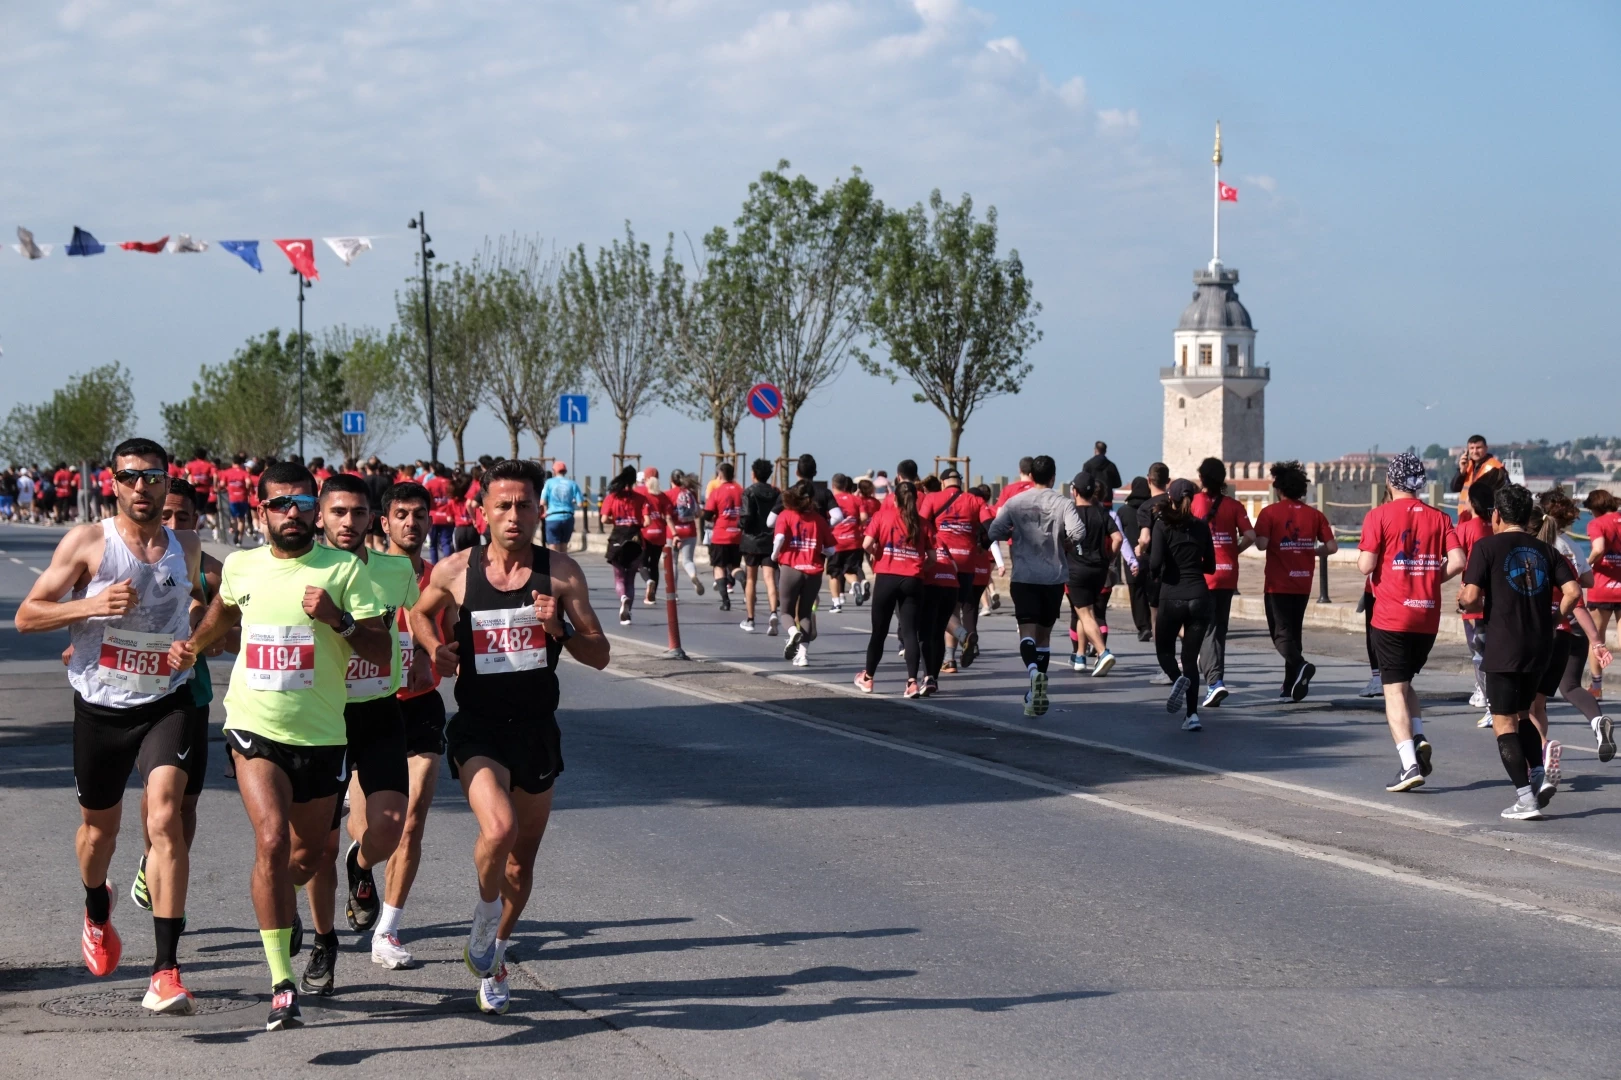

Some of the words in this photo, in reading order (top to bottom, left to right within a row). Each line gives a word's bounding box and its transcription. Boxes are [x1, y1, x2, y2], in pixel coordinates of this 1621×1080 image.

[486, 627, 533, 653] 2482
[116, 649, 160, 675] 1563
[257, 646, 302, 670] 1194
